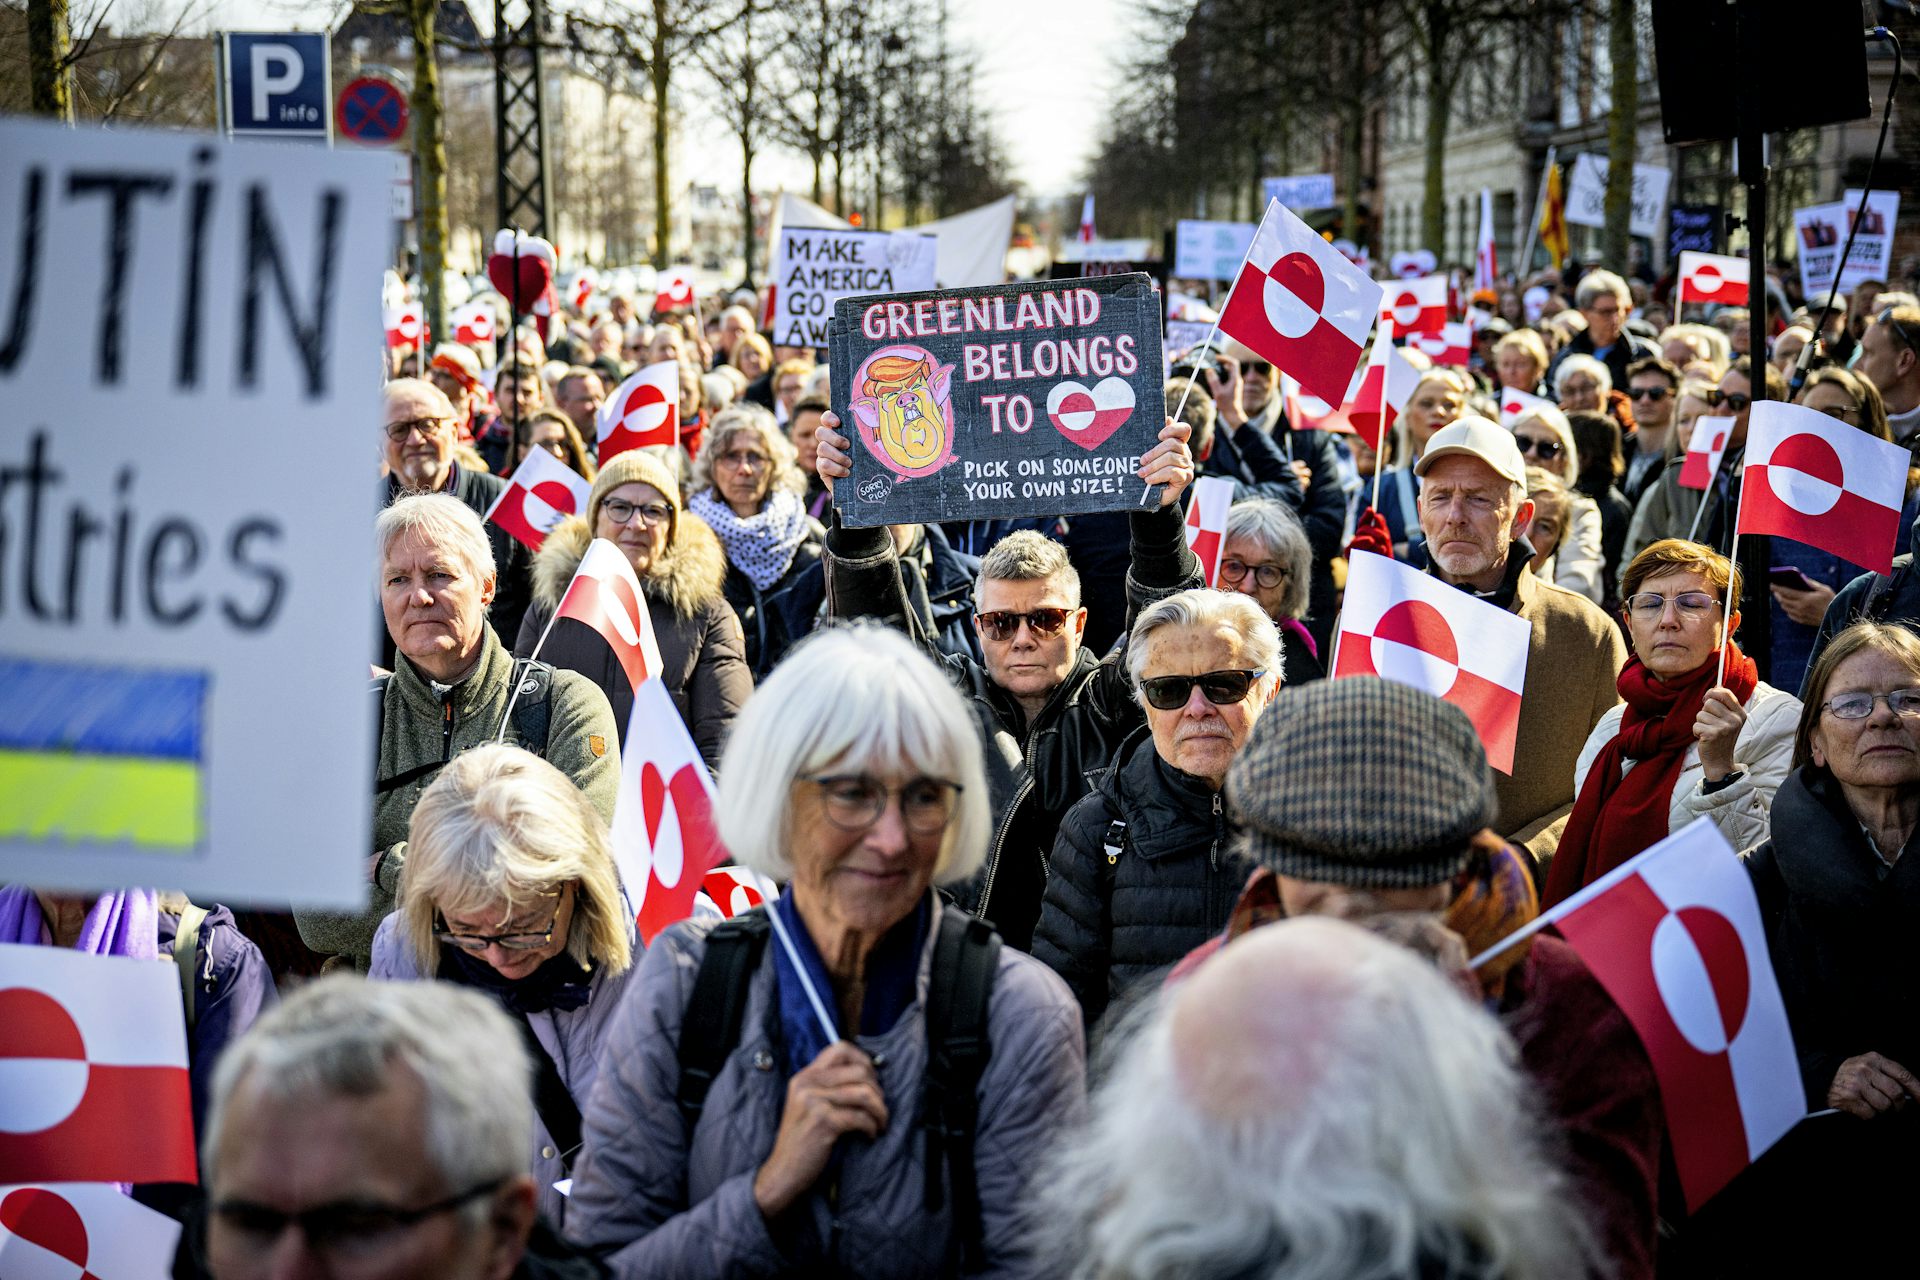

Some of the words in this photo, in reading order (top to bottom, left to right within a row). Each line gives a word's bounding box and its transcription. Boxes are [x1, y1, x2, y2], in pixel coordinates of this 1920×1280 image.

[251, 42, 305, 122] P
[279, 103, 320, 123] info
[787, 237, 865, 264] MAKE
[787, 265, 894, 292] AMERICA
[787, 291, 826, 317] GO
[862, 288, 1101, 340] GREENLAND
[963, 334, 1138, 383] BELONGS
[981, 394, 1034, 434] TO
[964, 460, 1010, 479] PICK
[1017, 458, 1045, 477] ON
[1052, 456, 1142, 477] SOMEONE
[860, 479, 884, 496] SORRY
[963, 481, 1016, 501] YOUR
[1022, 480, 1066, 499] OWN
[1070, 476, 1124, 495] SIZE!
[0, 428, 290, 632] tries
